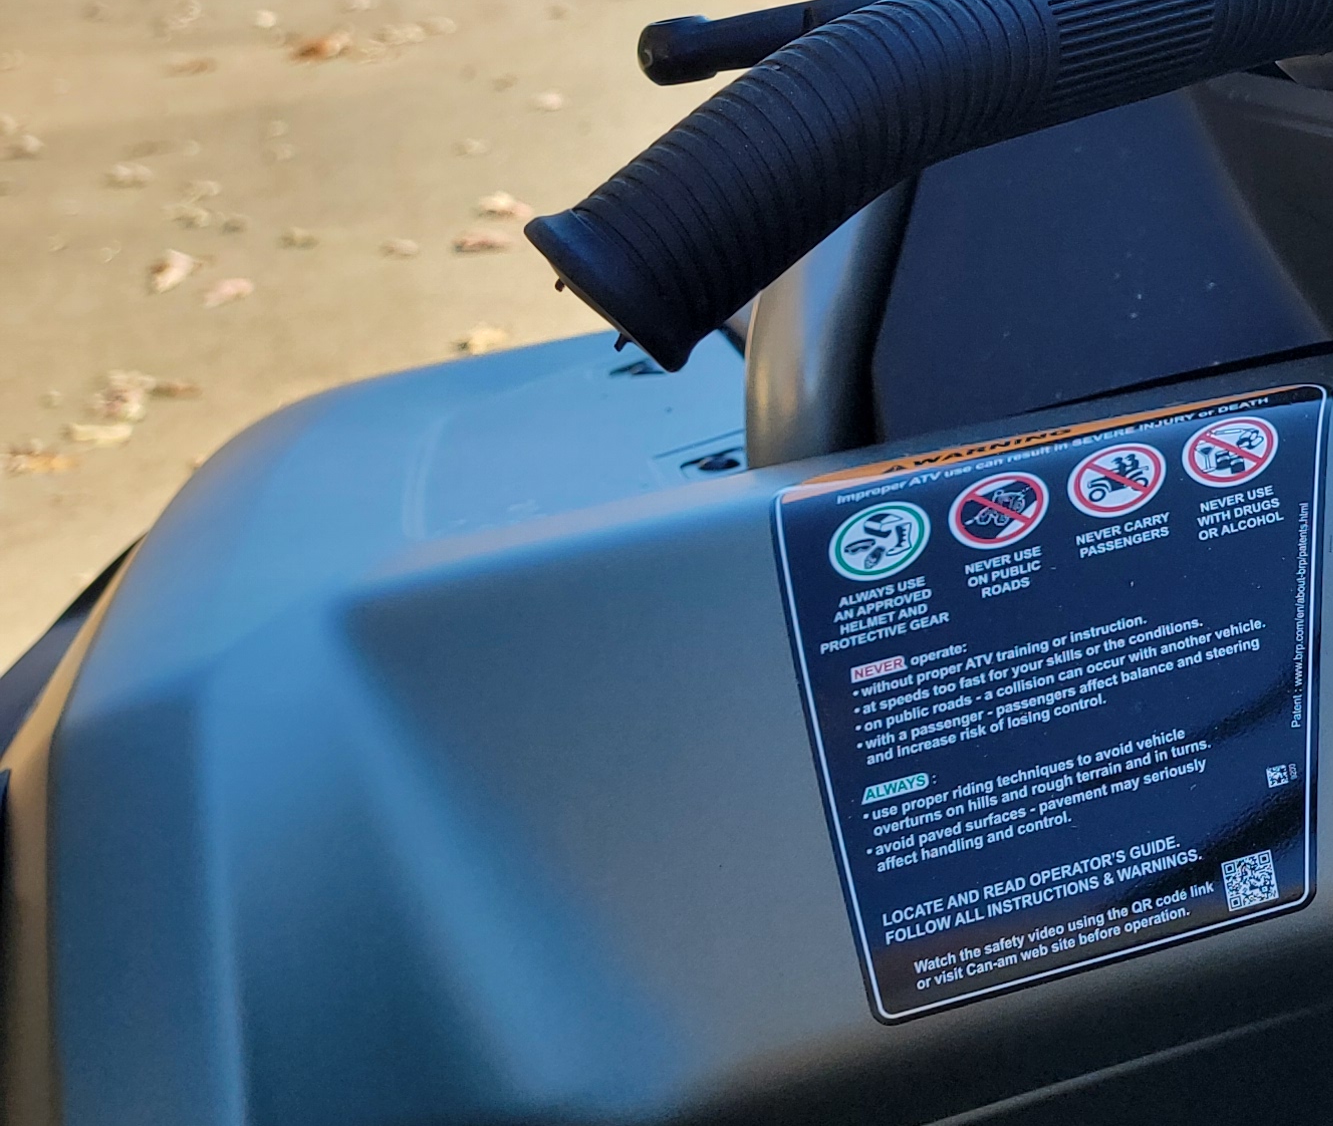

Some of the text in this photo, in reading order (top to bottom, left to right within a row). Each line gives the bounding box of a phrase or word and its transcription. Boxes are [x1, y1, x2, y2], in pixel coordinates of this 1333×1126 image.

[836, 397, 1269, 505] Improper ATV use can result in SEVERE INJURY or DEATH
[912, 428, 1072, 467] WARNING
[1197, 497, 1281, 527] WITH DRUGS
[1200, 485, 1274, 513] NEVER USE
[1076, 512, 1170, 546] NEVER CARRY
[1079, 526, 1170, 559] PASSENGERS
[1198, 511, 1285, 541] OR ALCOHOL
[965, 546, 1042, 575] NEVER USE
[967, 560, 1042, 588] ON PUBLIC
[833, 588, 933, 623] AN APPROVED
[839, 576, 926, 609] ALWAYS USE
[981, 577, 1031, 599] ROADS
[820, 612, 950, 655] PROTECTIVE GEAR
[840, 603, 929, 636] HELMET AND
[853, 643, 968, 680] NEVER operate:
[861, 616, 1148, 697] without proper ATV training or instruction.
[862, 619, 1204, 715] at speeds too fast for your skills or the conditions.
[864, 619, 1266, 732] on public roads a collision can occur with another vehicle.
[865, 638, 1260, 750] with a passenger passengers affect balance and steering
[1291, 694, 1303, 728] Patent
[867, 693, 1107, 766] and increase risk of losing control.
[865, 774, 926, 801] ALWAYS
[872, 728, 1186, 821] use proper riding techniques to avoid vehicle
[873, 740, 1212, 837] overturns on hills and rough terrain and in turns.
[875, 758, 1207, 856] avoid paved surfaces pavement may seriously
[877, 810, 1072, 873] affect handling and control.
[882, 835, 1181, 927] LOCATE AND READ OPERATOR'S GUIDE.
[885, 849, 1203, 946] FOLLOW ALL INSTRUCTIONS & WARNINGS.
[913, 881, 1215, 974] Watch the safety video using the QR code link
[916, 907, 1191, 991] or visit Can-am web site before operation.
